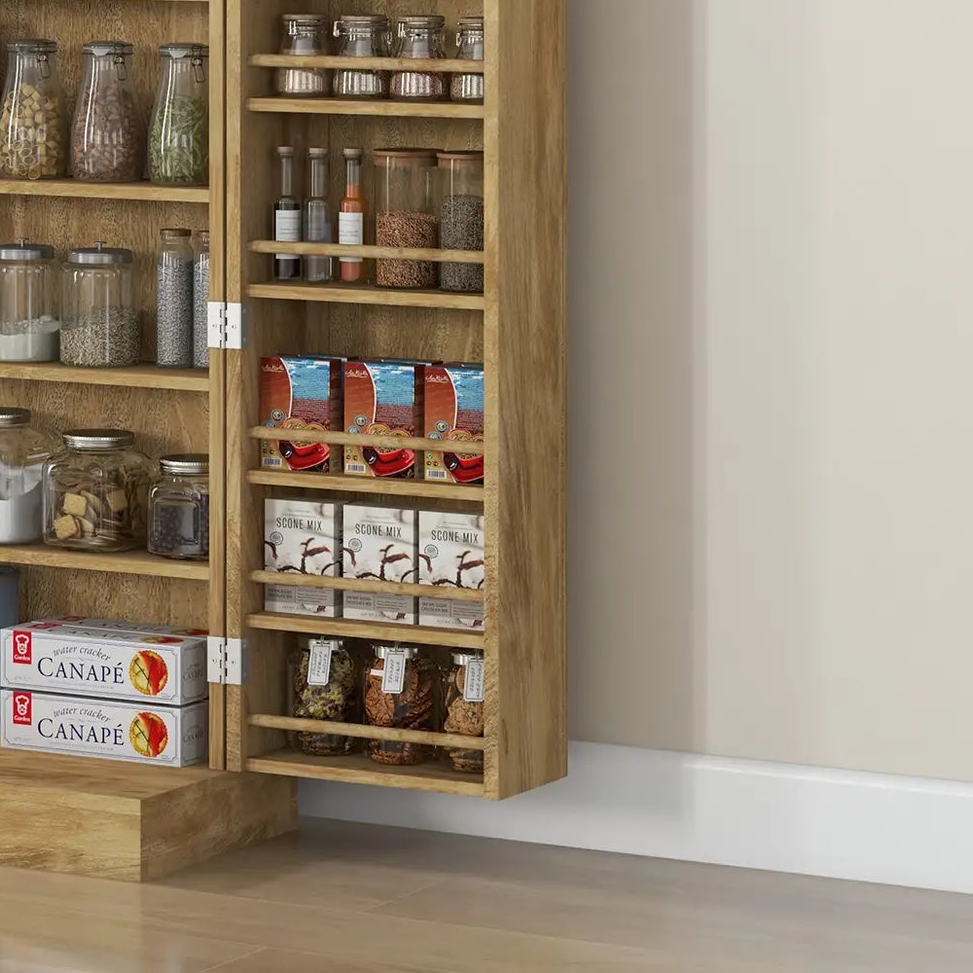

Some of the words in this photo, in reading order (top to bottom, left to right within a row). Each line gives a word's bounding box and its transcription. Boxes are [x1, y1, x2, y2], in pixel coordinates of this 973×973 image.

[276, 517, 303, 530] SCONE
[307, 519, 322, 531] MIX
[355, 523, 382, 537] SCONE
[385, 526, 402, 538] MIX
[431, 529, 459, 543] SCONE
[462, 532, 479, 544] MIX
[53, 646, 77, 657] water
[79, 646, 111, 662] cracker
[38, 656, 125, 684] CANAPÉ
[53, 707, 77, 718] water
[79, 707, 111, 723] cracker
[38, 717, 125, 746] CANAPÉ
